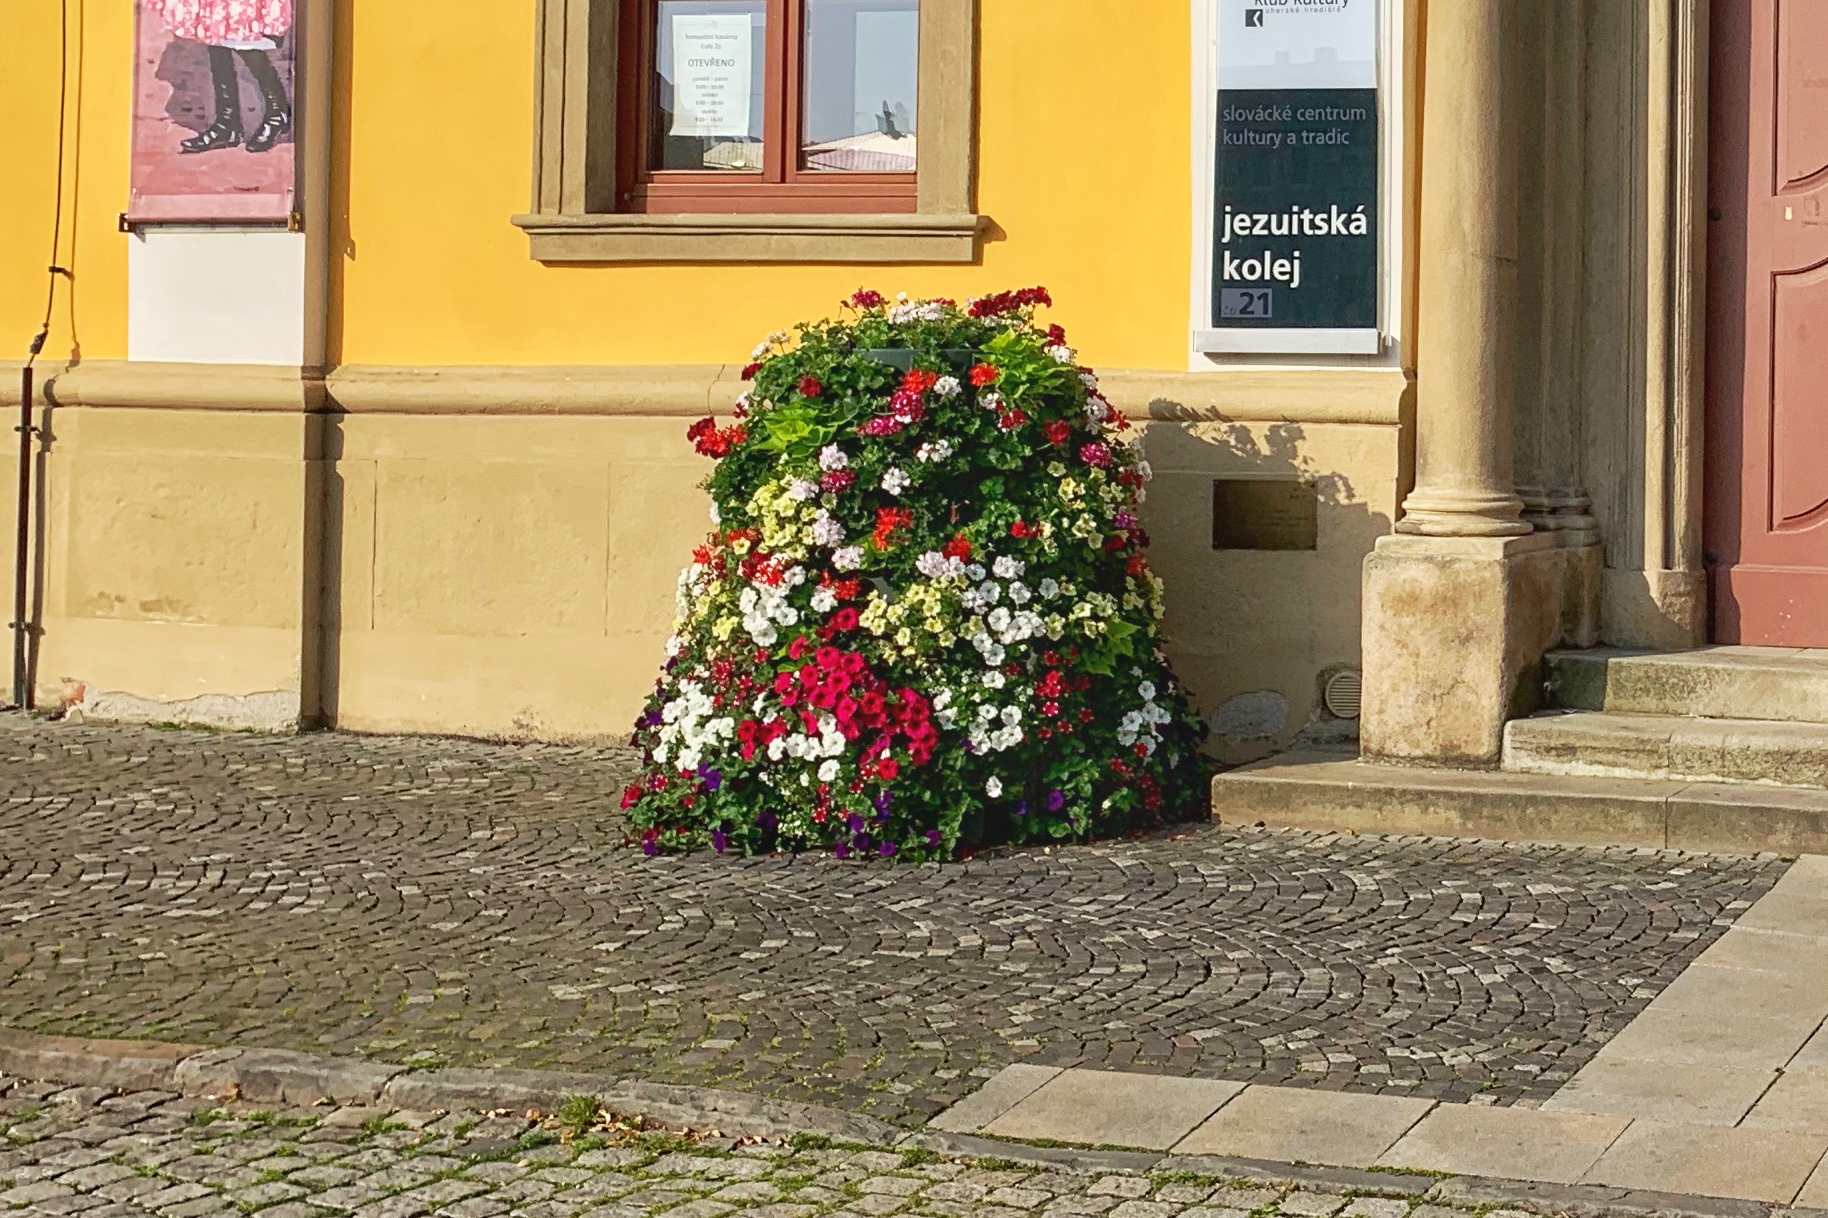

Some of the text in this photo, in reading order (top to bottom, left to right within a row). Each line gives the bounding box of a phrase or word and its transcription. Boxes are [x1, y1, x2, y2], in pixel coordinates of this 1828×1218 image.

[687, 56, 735, 68] OTEVŘENO
[1223, 105, 1367, 122] slovácké centrum
[1223, 128, 1350, 149] kultury a tradic
[1221, 204, 1367, 243] jezuitská
[1223, 250, 1300, 287] kolej
[1239, 291, 1269, 315] 21
